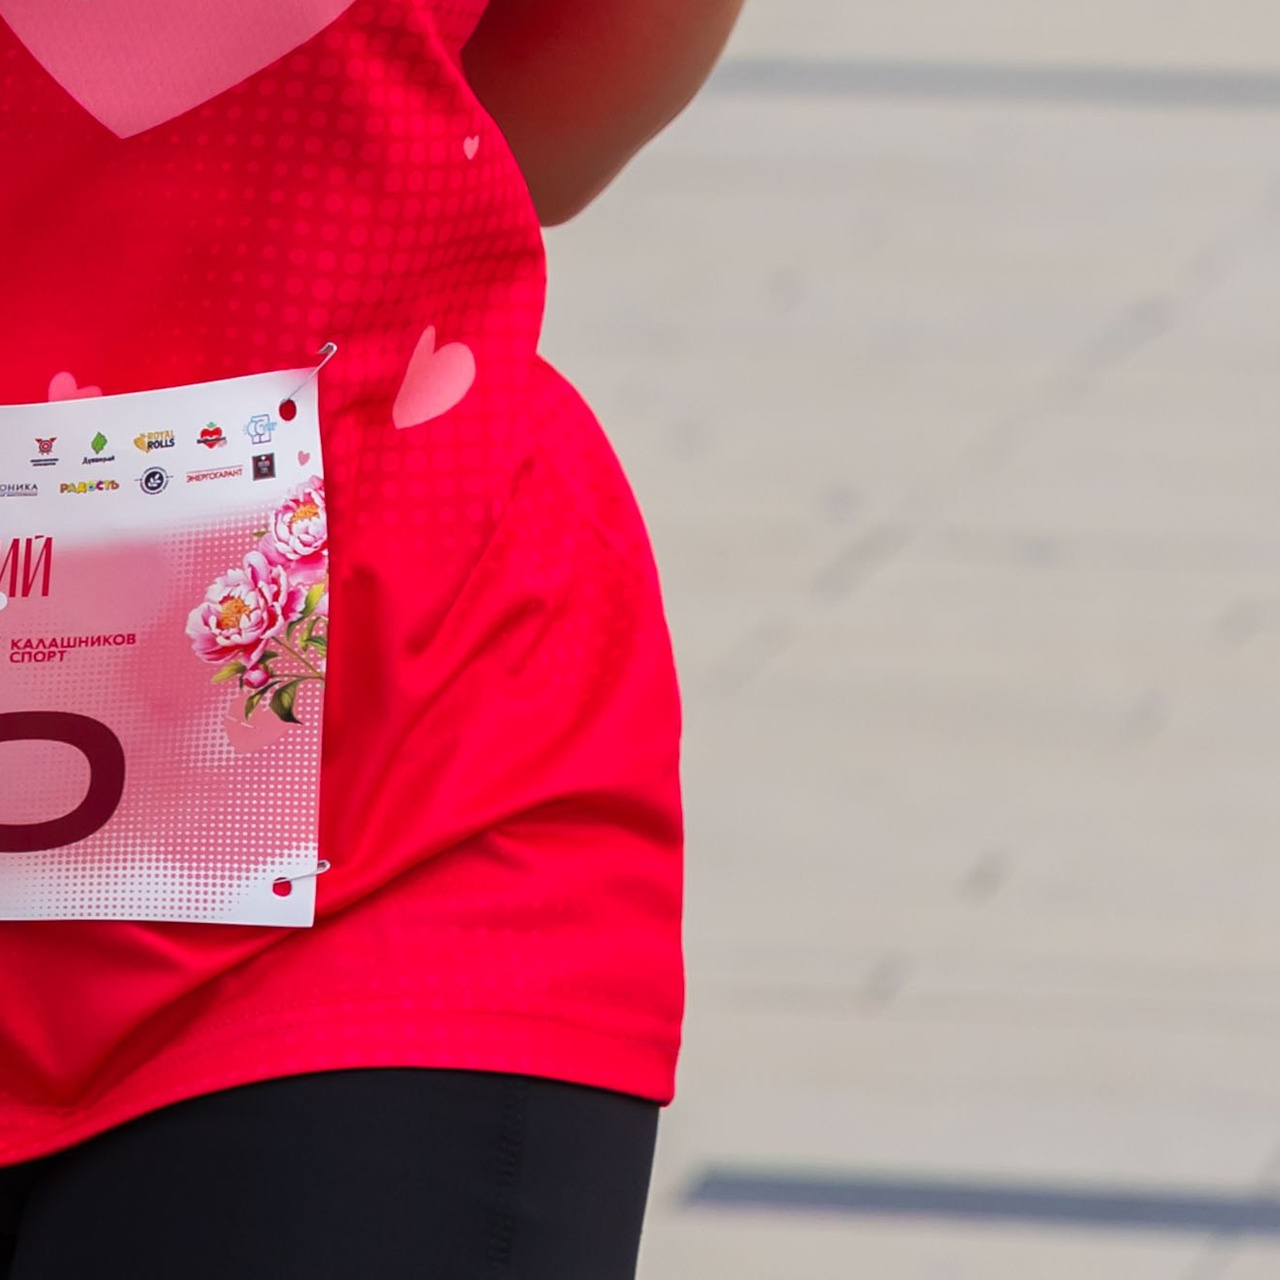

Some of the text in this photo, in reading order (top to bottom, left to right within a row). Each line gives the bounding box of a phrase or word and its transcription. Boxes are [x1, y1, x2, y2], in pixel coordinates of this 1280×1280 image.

[147, 437, 175, 450] ROLLS
[59, 480, 120, 495] РАДОСТЬ
[10, 632, 137, 653] КАЛАШНИКОВ
[9, 650, 67, 665] СПОРТ
